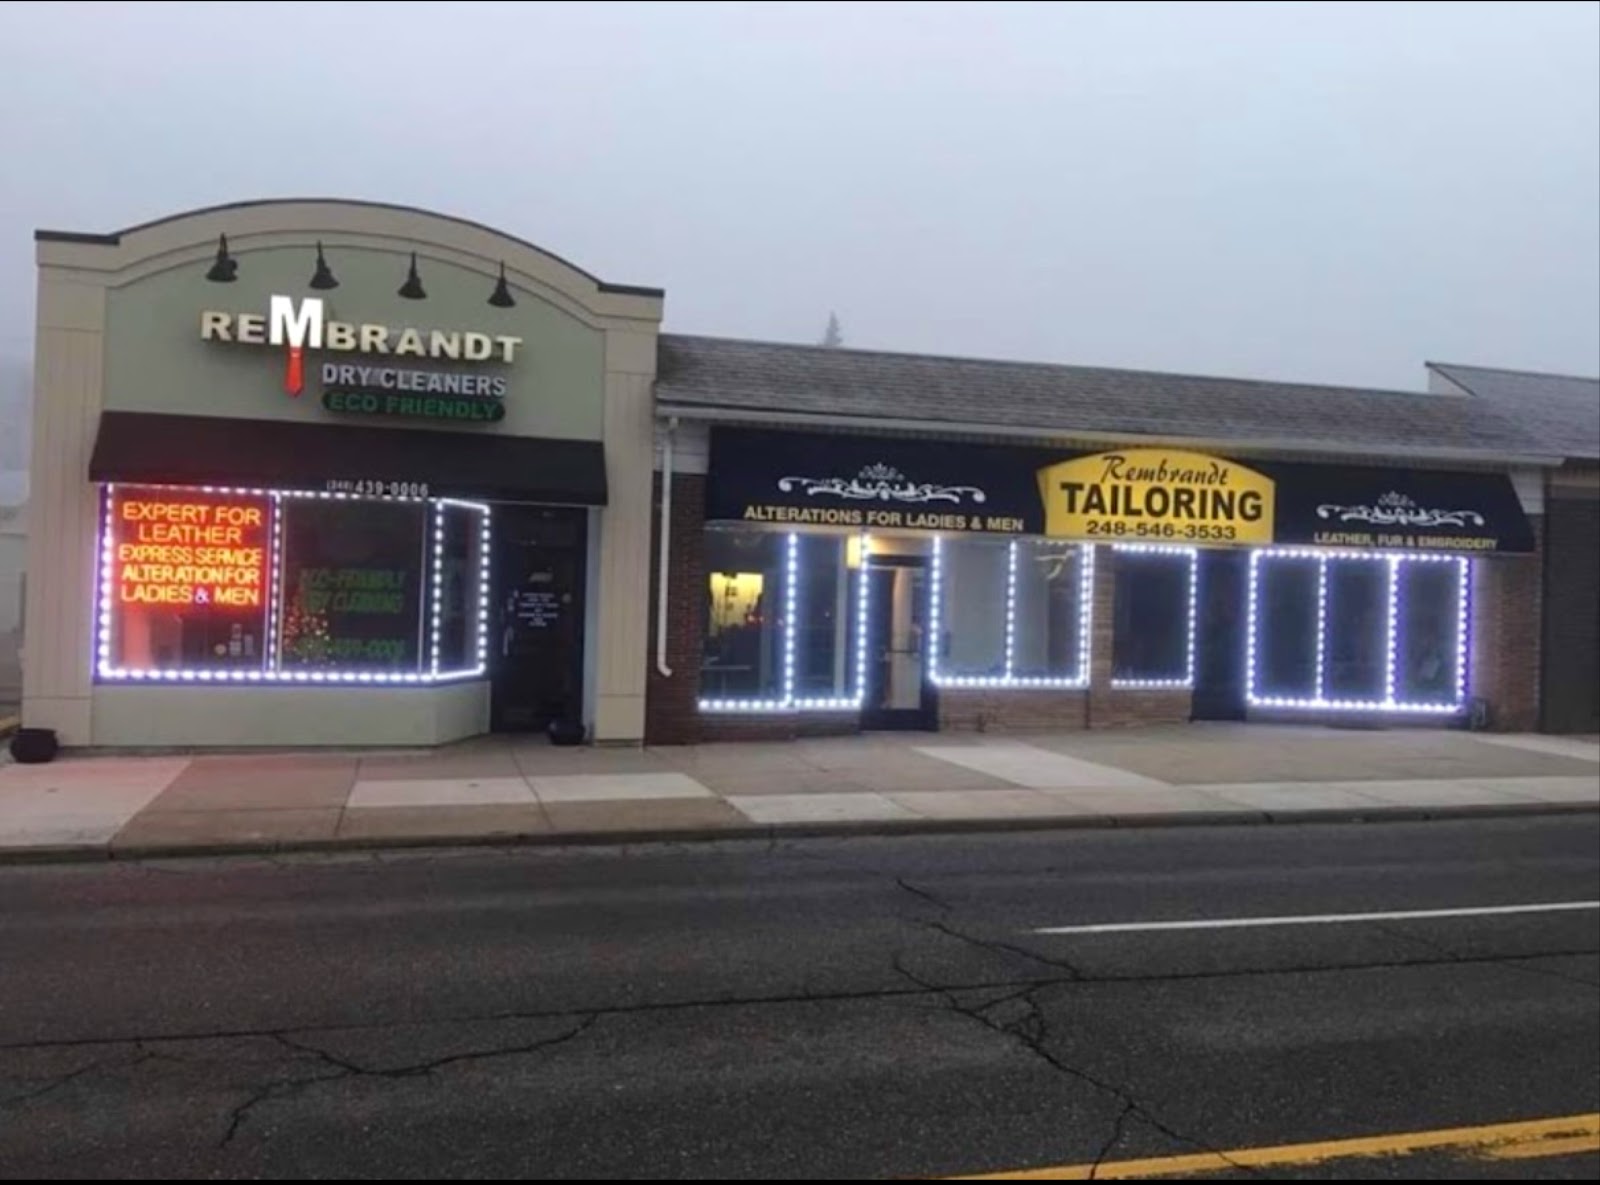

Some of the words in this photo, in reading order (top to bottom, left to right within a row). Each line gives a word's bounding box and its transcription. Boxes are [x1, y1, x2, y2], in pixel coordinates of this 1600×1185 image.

[200, 294, 523, 363] REMBRANDT
[322, 363, 371, 387] DRY
[380, 368, 507, 396] CLEANERS
[329, 393, 377, 411] ECO
[385, 396, 498, 420] FRIENDLY
[1101, 455, 1228, 485] Rembrandt
[122, 502, 210, 524] EXPERT
[215, 506, 262, 526] FOR
[1060, 482, 1263, 522] TAILORING
[743, 505, 863, 525] ALTERATIONS
[867, 510, 901, 526] FOR
[906, 512, 966, 529] LADIES
[969, 516, 982, 530] &
[986, 516, 1024, 531] MEN
[1086, 520, 1237, 540] 248-546-3533
[138, 523, 242, 544] LEATHER
[1378, 534, 1405, 547] FUR
[1406, 536, 1415, 547] &
[1418, 536, 1498, 550] EMBROIDERY
[118, 543, 193, 564] EXPRESS
[195, 548, 263, 566] SERVICE
[122, 564, 223, 584] ALTERATION
[225, 567, 261, 585] FOR
[120, 584, 194, 603] LADIES
[194, 587, 210, 604] &
[213, 587, 260, 605] MEN
